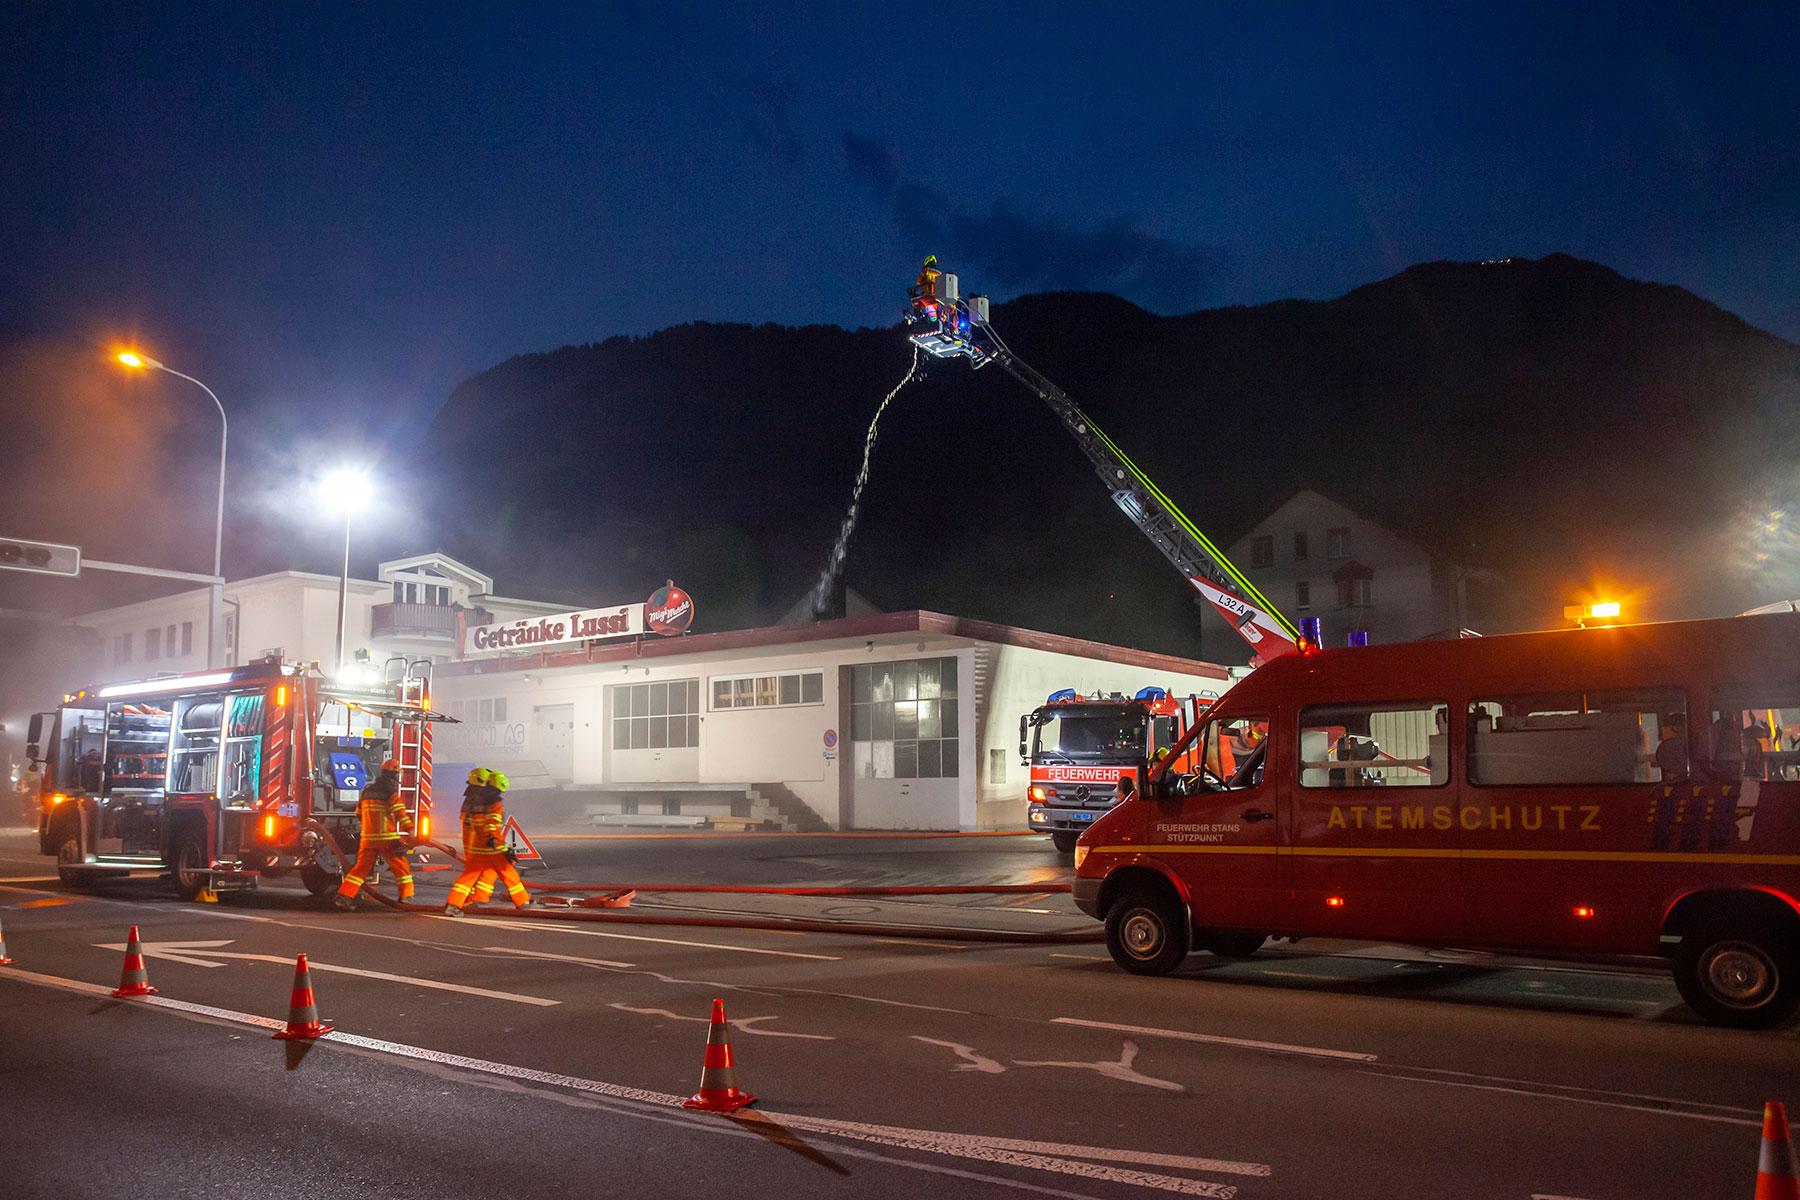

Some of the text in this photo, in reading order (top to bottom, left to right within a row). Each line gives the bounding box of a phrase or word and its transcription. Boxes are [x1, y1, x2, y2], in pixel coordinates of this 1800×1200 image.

[1218, 594, 1237, 610] L32
[473, 608, 629, 649] Getränke Lussi
[503, 723, 525, 745] AG
[1048, 768, 1120, 780] FEUERWEHR
[1327, 805, 1600, 831] ATEMSCHUTZ
[1156, 824, 1240, 832] FEUERWEHR STANS
[1167, 832, 1224, 842] STÜTZPUNKT
